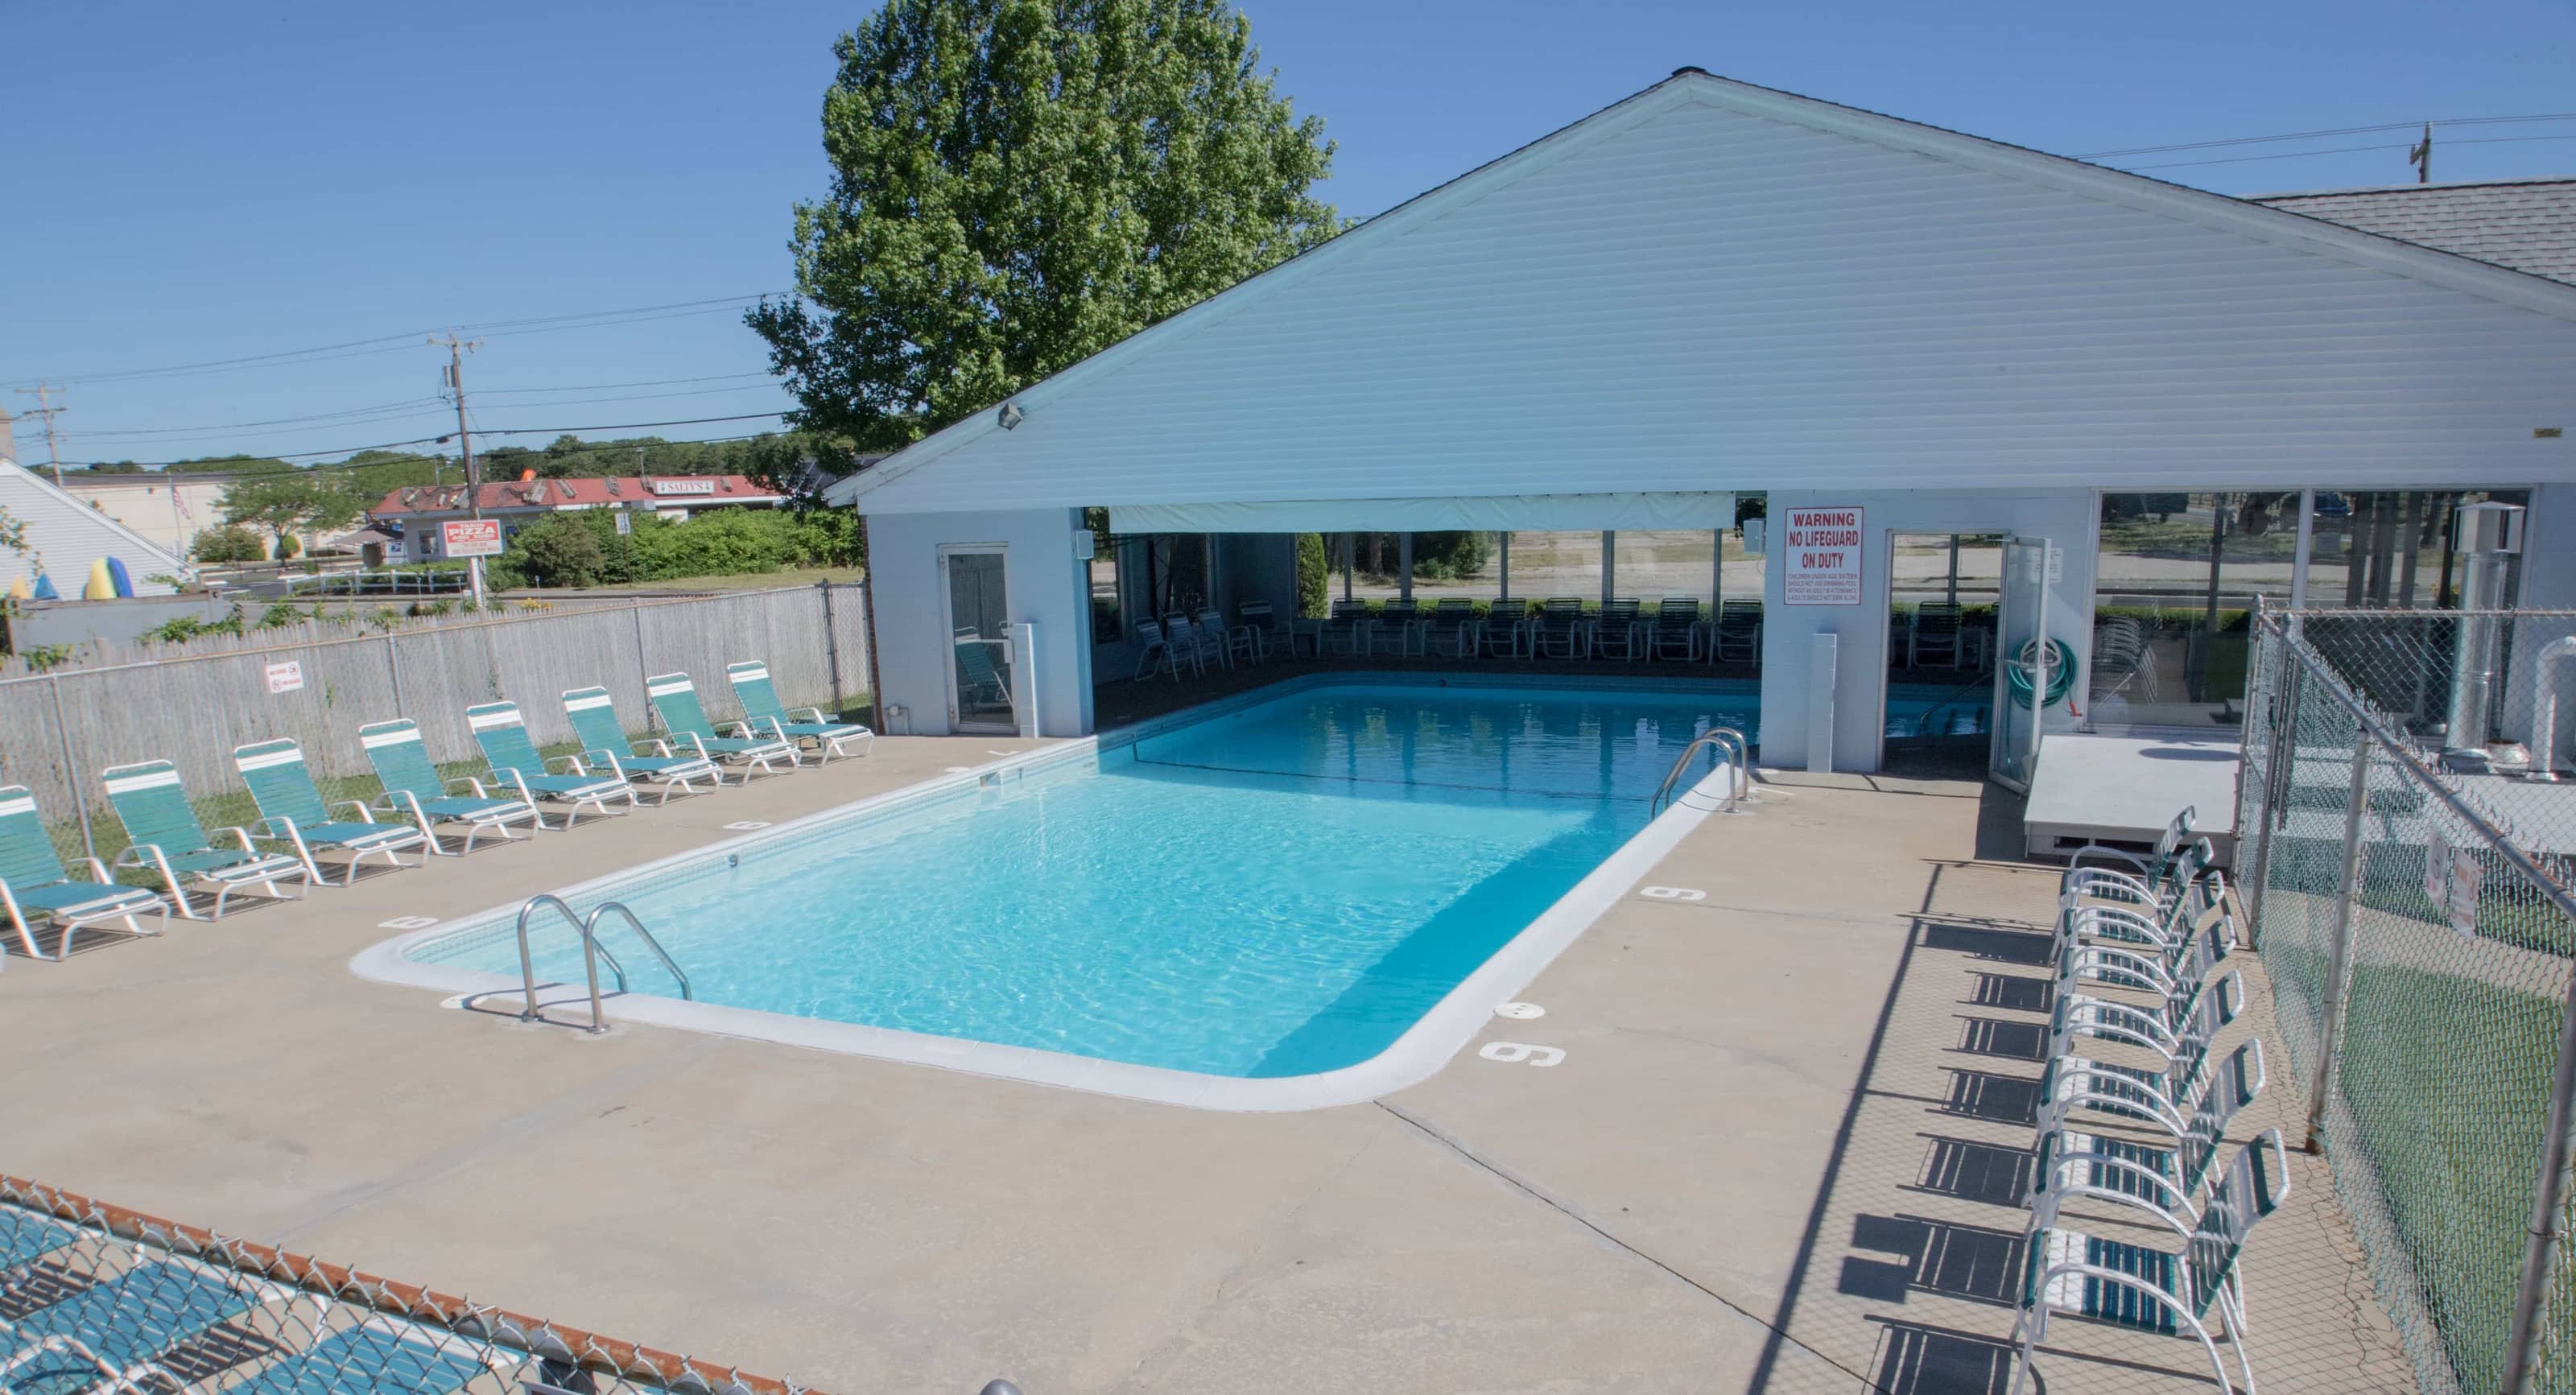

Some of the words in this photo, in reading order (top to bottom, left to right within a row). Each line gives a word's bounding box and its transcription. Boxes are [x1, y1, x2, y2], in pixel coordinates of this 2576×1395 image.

[668, 482, 704, 492] SALTY'S
[1794, 512, 1856, 527] WARNING
[448, 526, 496, 536] PIZZA
[1790, 530, 1802, 547] NO
[1805, 530, 1859, 547] LIFEGUARD
[1802, 552, 1815, 569] ON
[1818, 552, 1844, 568] DUTY
[729, 854, 738, 868] 9
